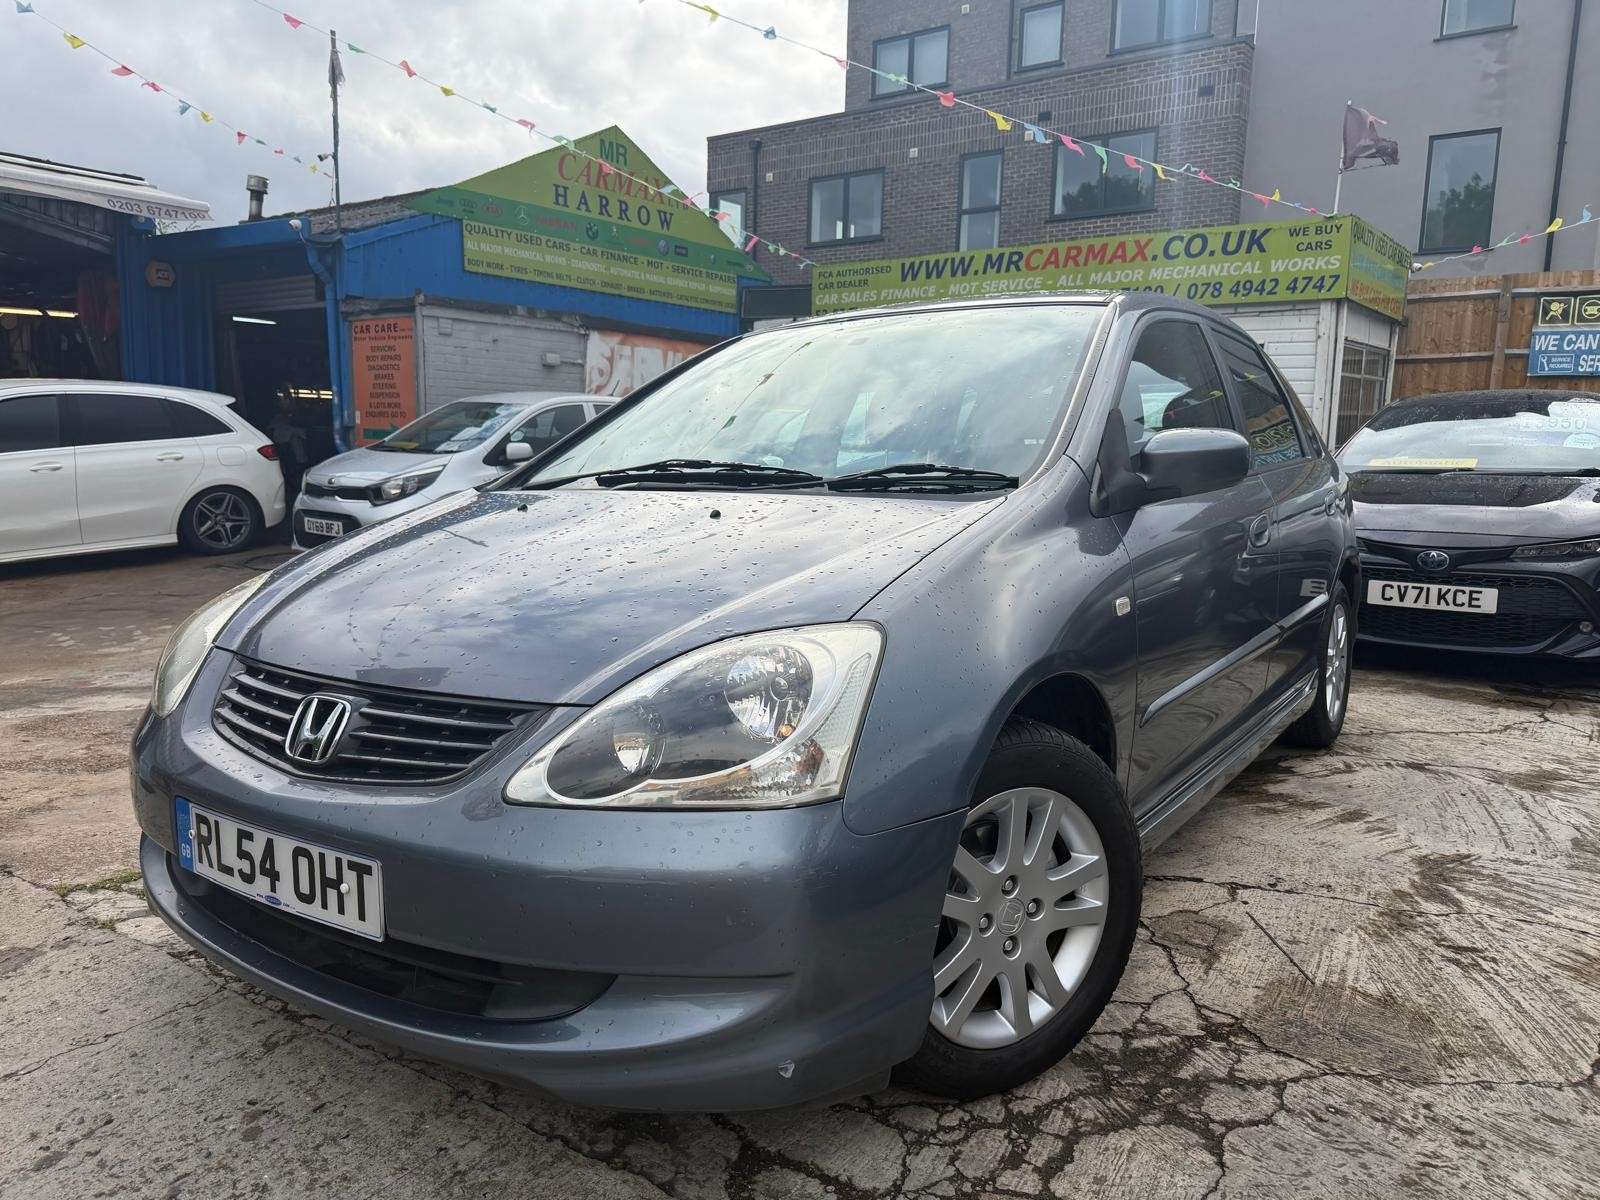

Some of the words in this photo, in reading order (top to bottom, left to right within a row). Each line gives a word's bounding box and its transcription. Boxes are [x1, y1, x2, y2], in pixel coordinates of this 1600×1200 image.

[599, 139, 628, 168] MR
[558, 153, 665, 205] CARMAX
[107, 199, 143, 214] 0203
[553, 184, 674, 233] HARROW
[1289, 225, 1310, 238] WE
[1315, 223, 1343, 236] BUY
[465, 222, 512, 241] QUALITY
[515, 232, 543, 247] USED
[546, 238, 571, 253] CARS
[580, 246, 598, 258] CAR
[600, 250, 639, 266] FINANCE
[671, 264, 704, 279] SERVICE
[705, 271, 736, 285] REPAIRS
[466, 240, 479, 251] ALL
[480, 242, 503, 255] MAJOR
[504, 245, 544, 261] MECHANICAL
[1296, 239, 1333, 252] CARS
[900, 227, 1273, 283] WWW.MRCARMAX.CO.UK
[815, 293, 838, 305] CAR
[841, 290, 878, 303] SALES
[881, 285, 937, 300] FINANCE
[948, 282, 977, 295] MOT
[981, 276, 1044, 293] SERVICE
[1056, 274, 1084, 288] ALL
[1089, 269, 1143, 285] MAJOR
[1149, 260, 1263, 280] MECHANICAL
[1270, 255, 1342, 273] WORKS
[818, 270, 834, 280] FCA
[836, 265, 892, 278] AUTHORISED
[818, 282, 834, 291] CAR
[837, 279, 869, 289] DEALER
[1186, 281, 1224, 300] 078
[1229, 277, 1280, 298] 4942
[1286, 274, 1341, 295] 4747
[354, 324, 371, 335] CAR
[374, 322, 399, 333] CARE
[1535, 334, 1560, 351] WE
[1563, 334, 1600, 351] CAN
[369, 391, 400, 399] SUSPENSION
[391, 410, 399, 418] GO
[400, 410, 407, 418] TO
[325, 522, 340, 535] BFJ
[1381, 583, 1430, 606] CV71
[1437, 587, 1483, 609] KCE
[181, 843, 191, 858] GB
[195, 812, 280, 894] RL54
[291, 845, 373, 923] OHT
